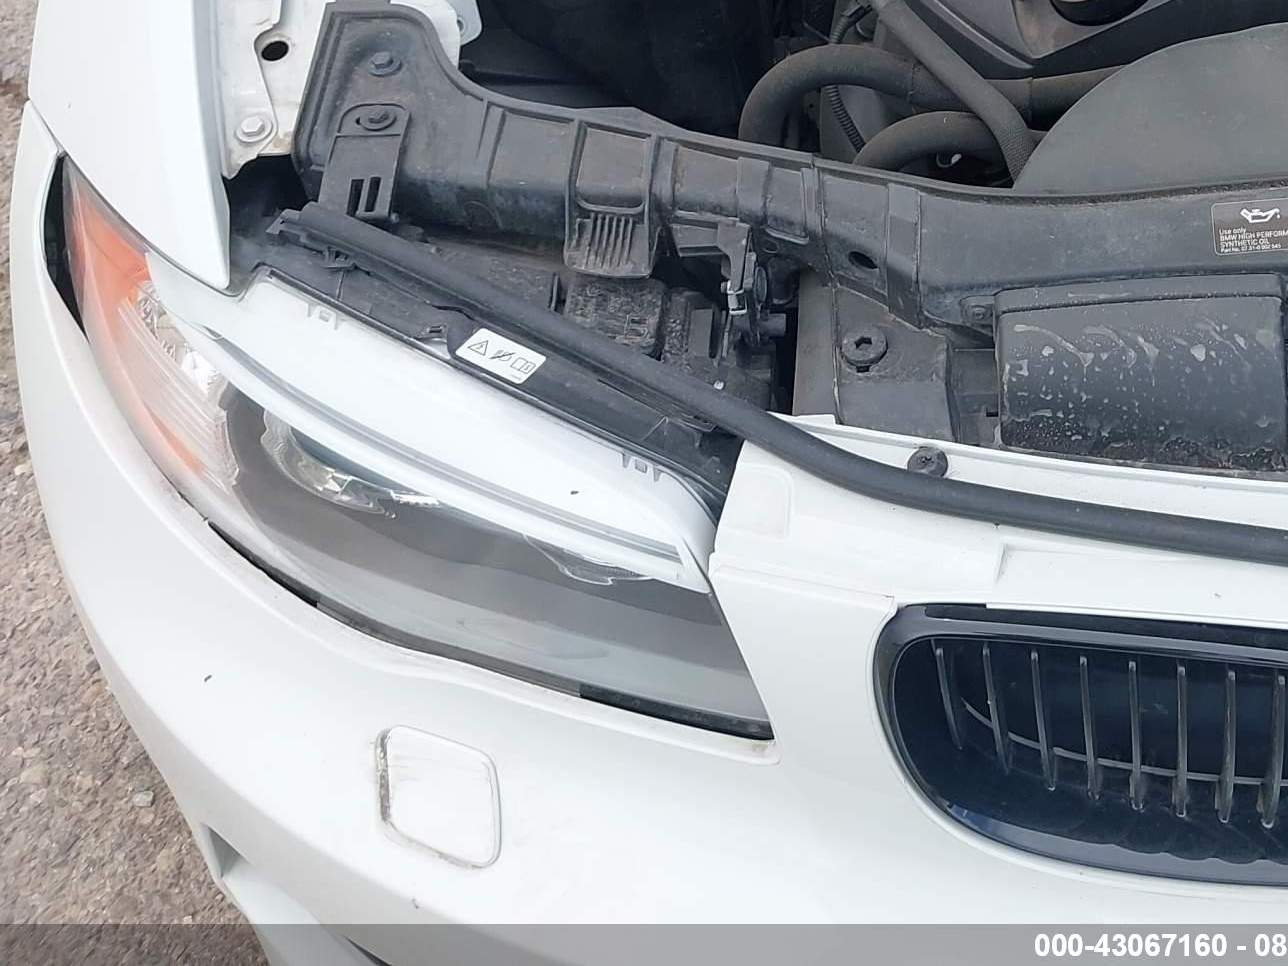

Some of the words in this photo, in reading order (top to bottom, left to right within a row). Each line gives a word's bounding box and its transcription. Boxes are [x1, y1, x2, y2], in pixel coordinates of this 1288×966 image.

[1232, 226, 1247, 235] only
[1238, 232, 1255, 240] HIGH
[1220, 239, 1258, 248] SYNTHETIC
[1259, 237, 1270, 245] OIL
